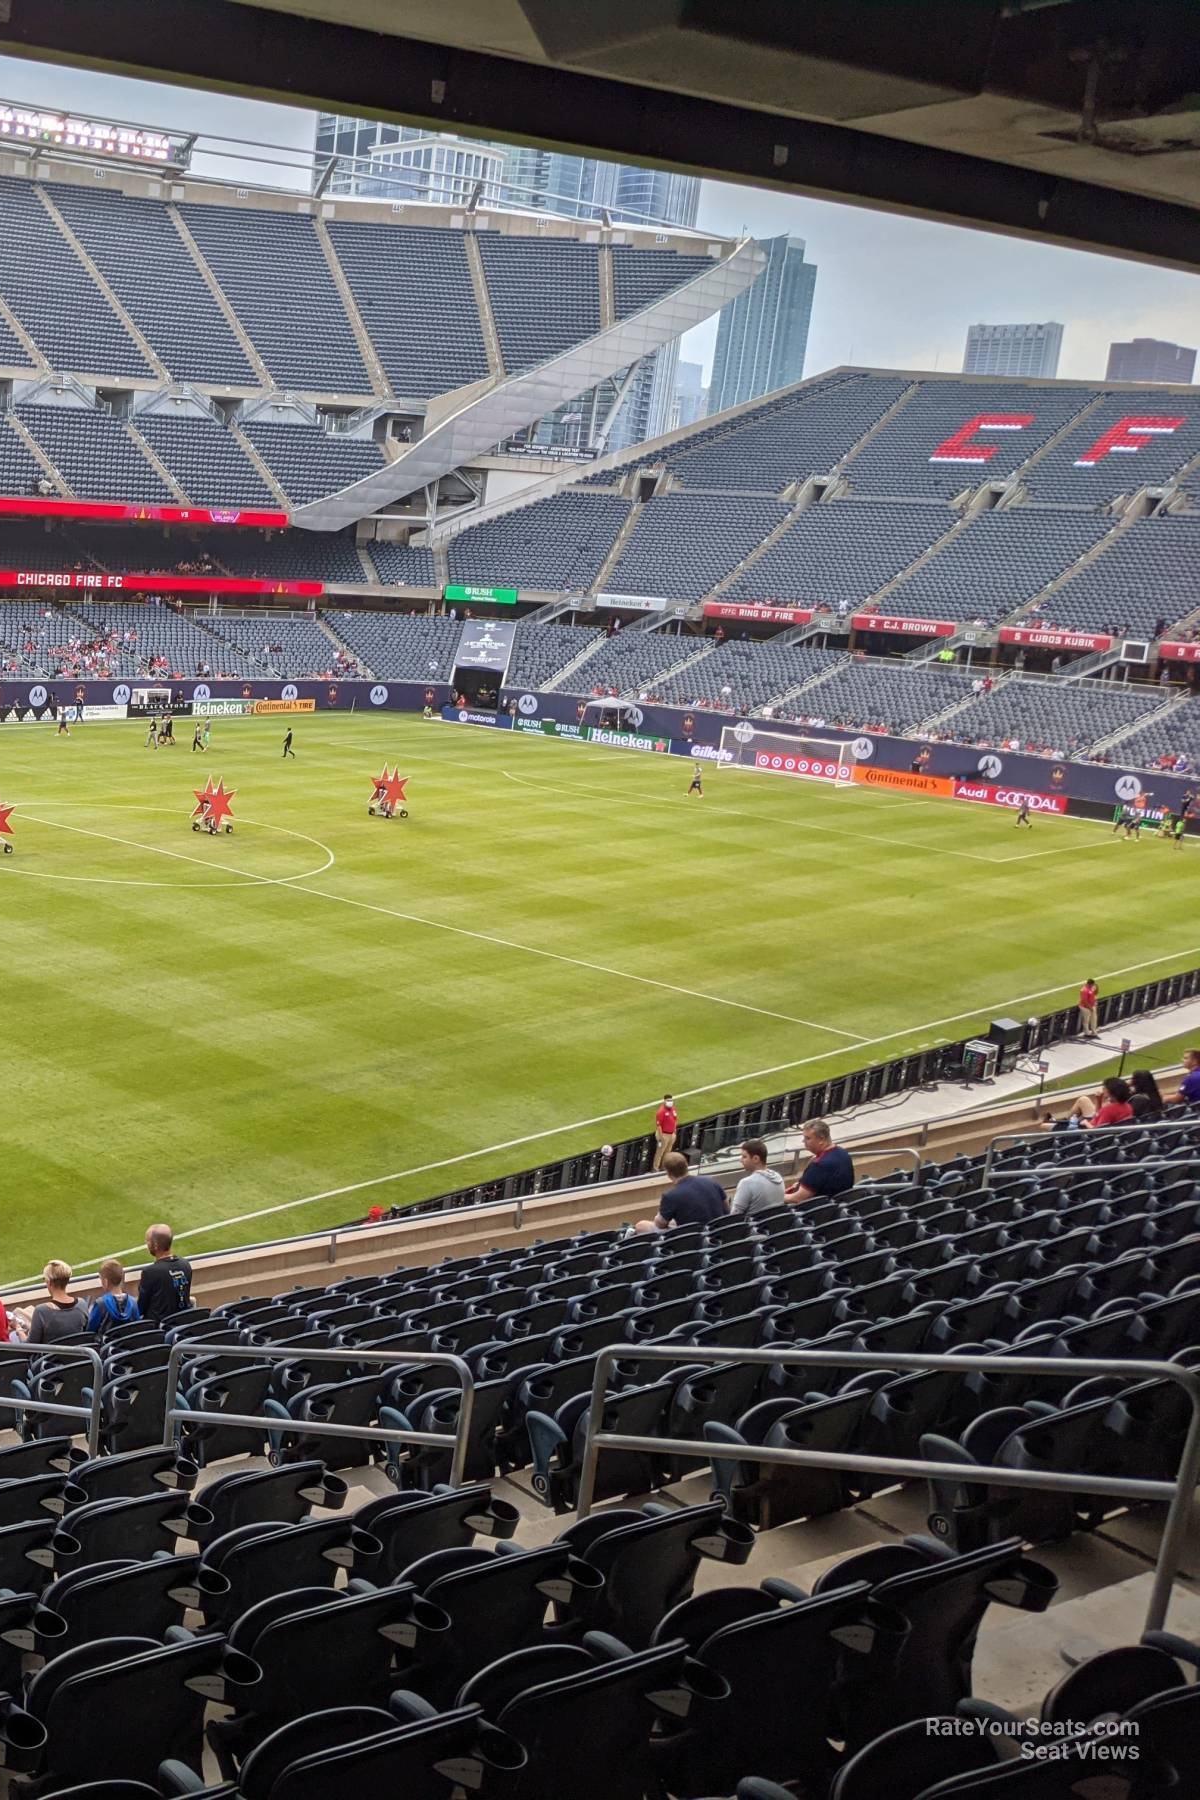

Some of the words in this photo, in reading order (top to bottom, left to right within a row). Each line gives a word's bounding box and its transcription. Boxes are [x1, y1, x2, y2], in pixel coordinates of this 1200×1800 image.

[928, 413, 1036, 464] C
[1073, 416, 1188, 469] F
[17, 573, 71, 586] CHICAGO
[75, 575, 103, 587] FIRE
[107, 575, 123, 588] FC
[471, 587, 493, 596] RUSH
[609, 599, 642, 607] Heineken
[738, 608, 759, 618] RING
[761, 610, 772, 619] OF
[774, 611, 794, 621] FIRE
[869, 619, 876, 628] 2
[883, 621, 899, 630] C.J.
[902, 623, 937, 633] BROWN
[1029, 633, 1062, 645] LUBOS
[1064, 637, 1096, 648] KUBIK
[192, 702, 243, 715] Heineken
[255, 701, 292, 713] Continental
[467, 713, 496, 724] motorola
[523, 719, 542, 728] RUSH
[560, 723, 580, 734] RUSH
[590, 728, 652, 750] Heineken
[864, 770, 928, 790] Continental
[956, 785, 988, 799] Audi
